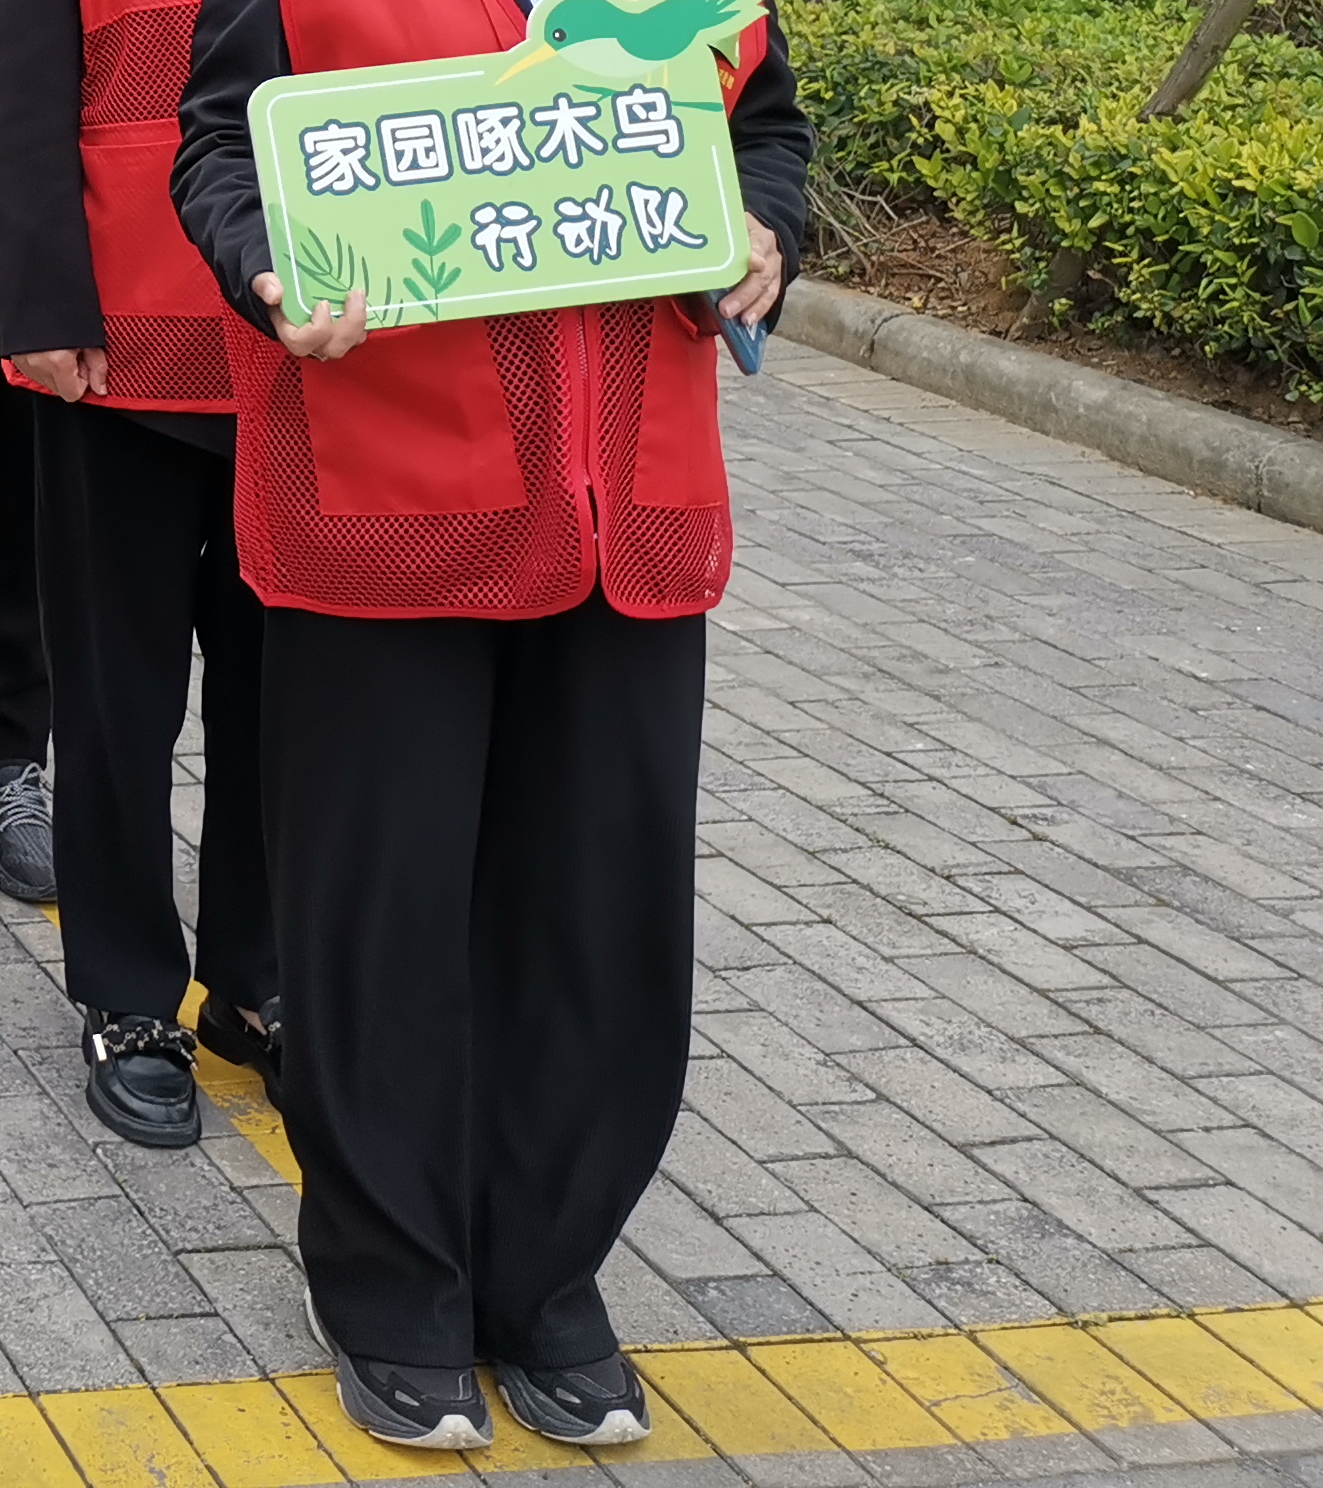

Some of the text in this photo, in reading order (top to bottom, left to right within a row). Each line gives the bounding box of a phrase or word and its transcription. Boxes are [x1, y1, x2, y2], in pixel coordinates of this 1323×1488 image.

[300, 83, 685, 196] 家园啄木鸟
[471, 181, 708, 271] 行动队
